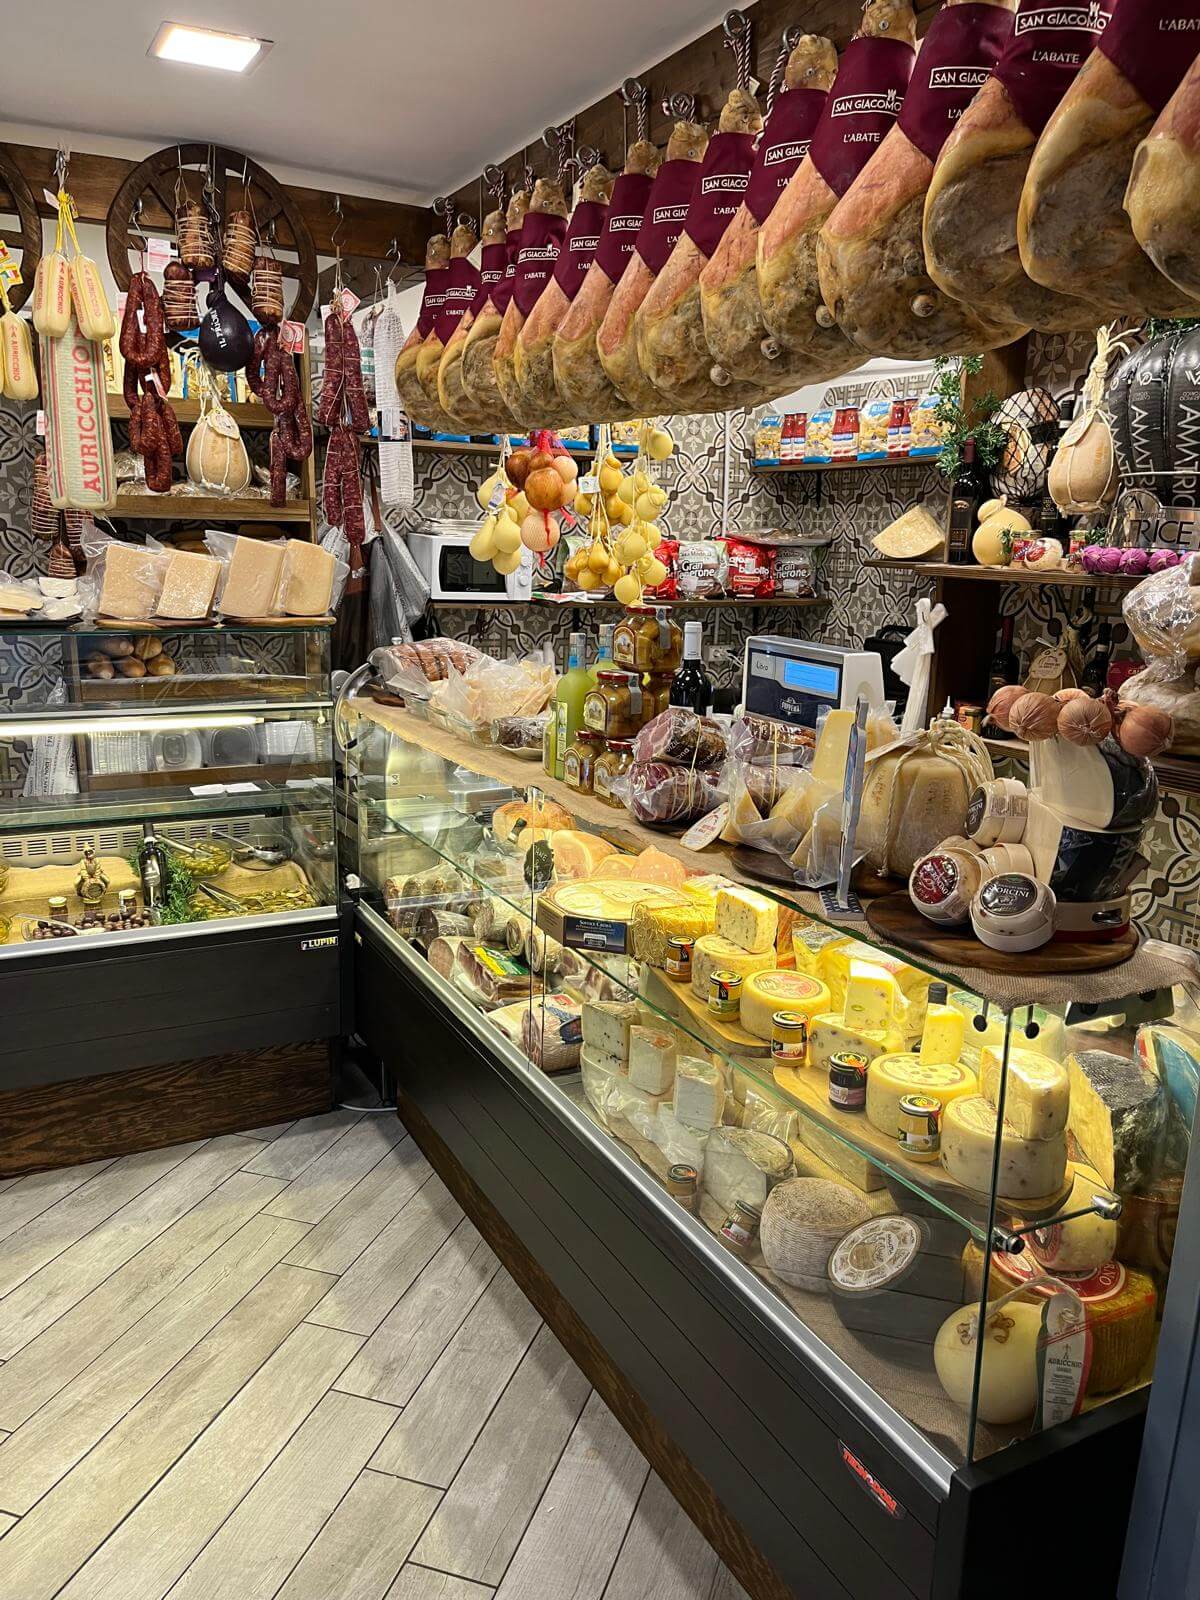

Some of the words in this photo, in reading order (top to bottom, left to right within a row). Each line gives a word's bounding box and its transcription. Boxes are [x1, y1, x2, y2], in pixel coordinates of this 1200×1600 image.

[1019, 14, 1043, 30] SAN
[1049, 12, 1108, 30] GIACOMO
[1032, 50, 1080, 65] L'ABATE
[933, 72, 957, 85] SAN
[834, 101, 853, 113] SAN
[854, 99, 902, 111] GIACOMO
[843, 132, 881, 143] L'ABATE
[767, 148, 784, 161] SAN
[704, 180, 720, 190] SAN
[720, 179, 749, 188] GIACO
[655, 211, 671, 220] SAN
[612, 220, 626, 229] SAN
[572, 240, 584, 248] SAN
[527, 249, 559, 258] GIACOMO
[524, 272, 546, 280] L'ABATE
[71, 344, 102, 495] AURICCHIO
[308, 936, 336, 948] LUPIN
